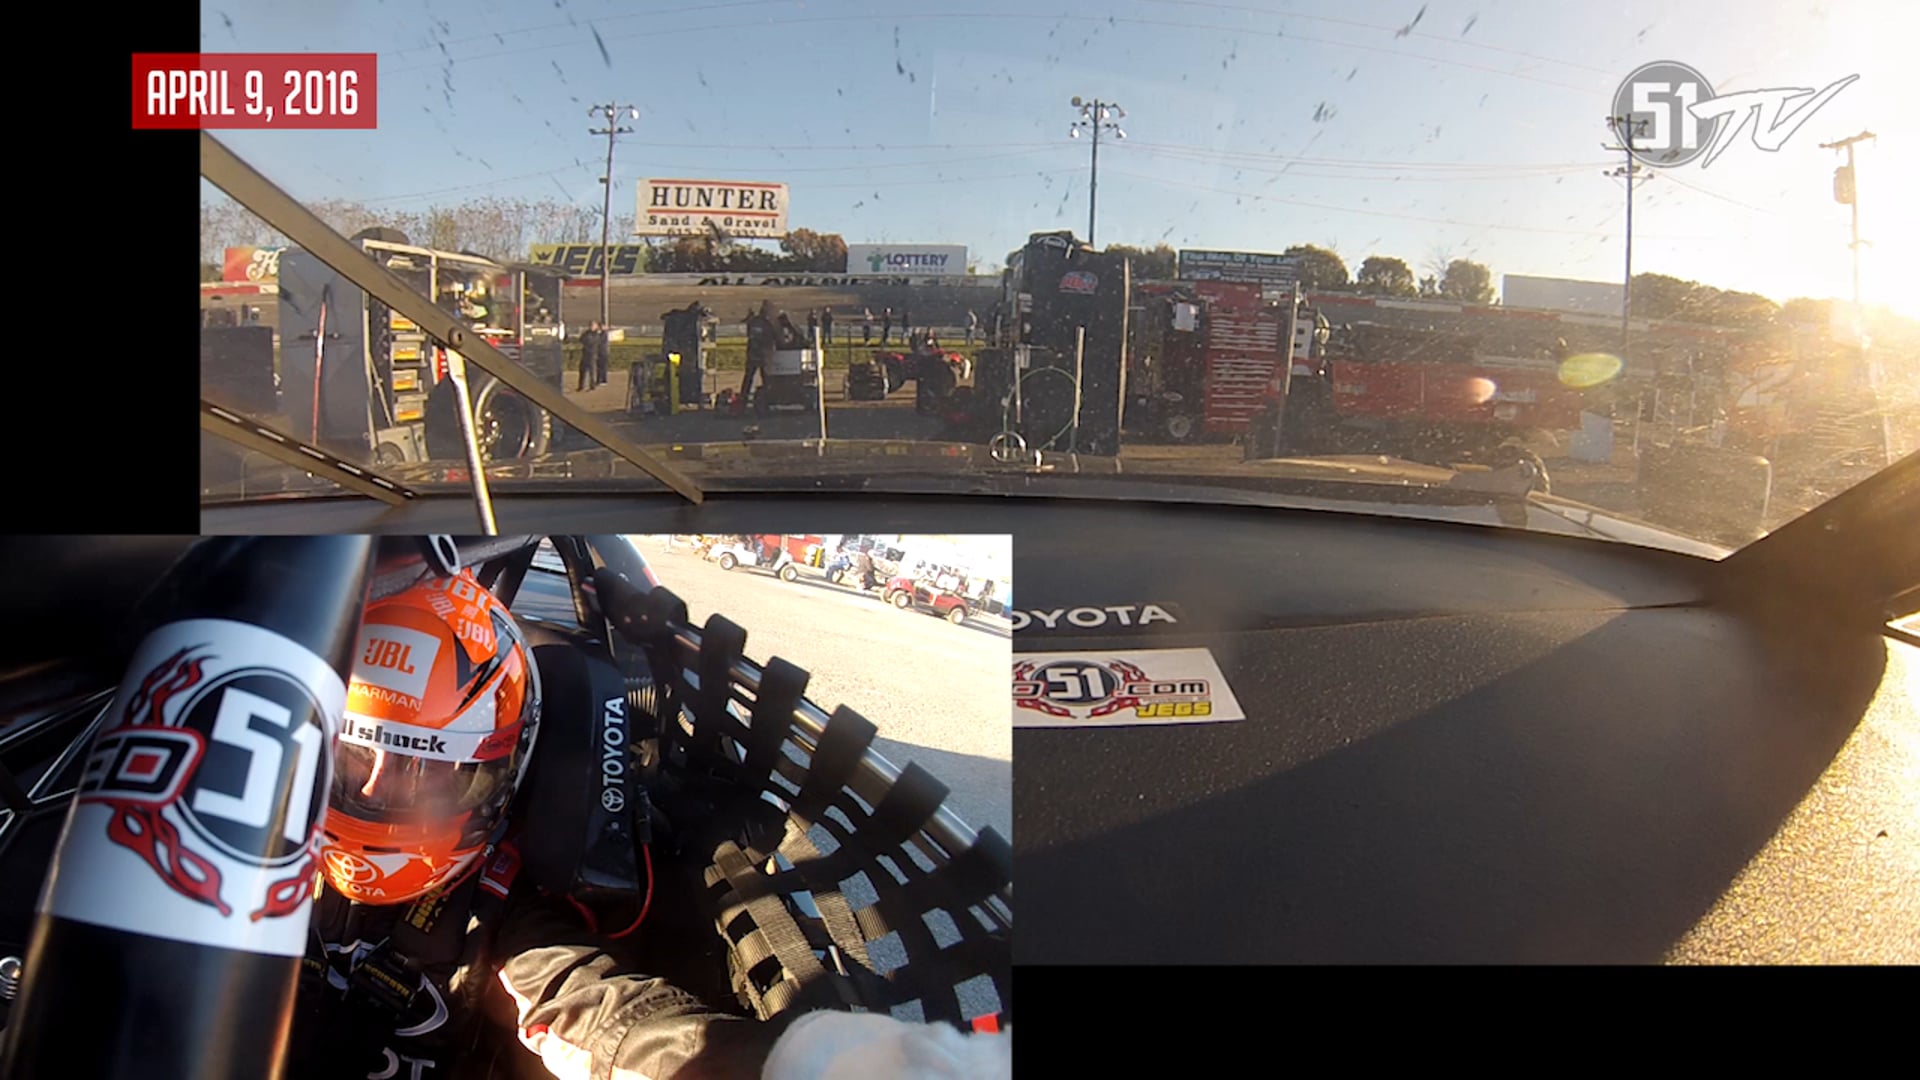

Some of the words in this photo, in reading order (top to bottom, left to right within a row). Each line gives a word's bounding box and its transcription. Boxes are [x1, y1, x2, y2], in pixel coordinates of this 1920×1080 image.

[650, 186, 778, 210] HUNTER
[649, 215, 690, 226] Sand
[887, 254, 948, 266] LOTTERY
[456, 618, 494, 653] JBL
[363, 637, 416, 676] JBL
[1136, 701, 1211, 717] JEGS
[602, 697, 625, 786] TOYOTA
